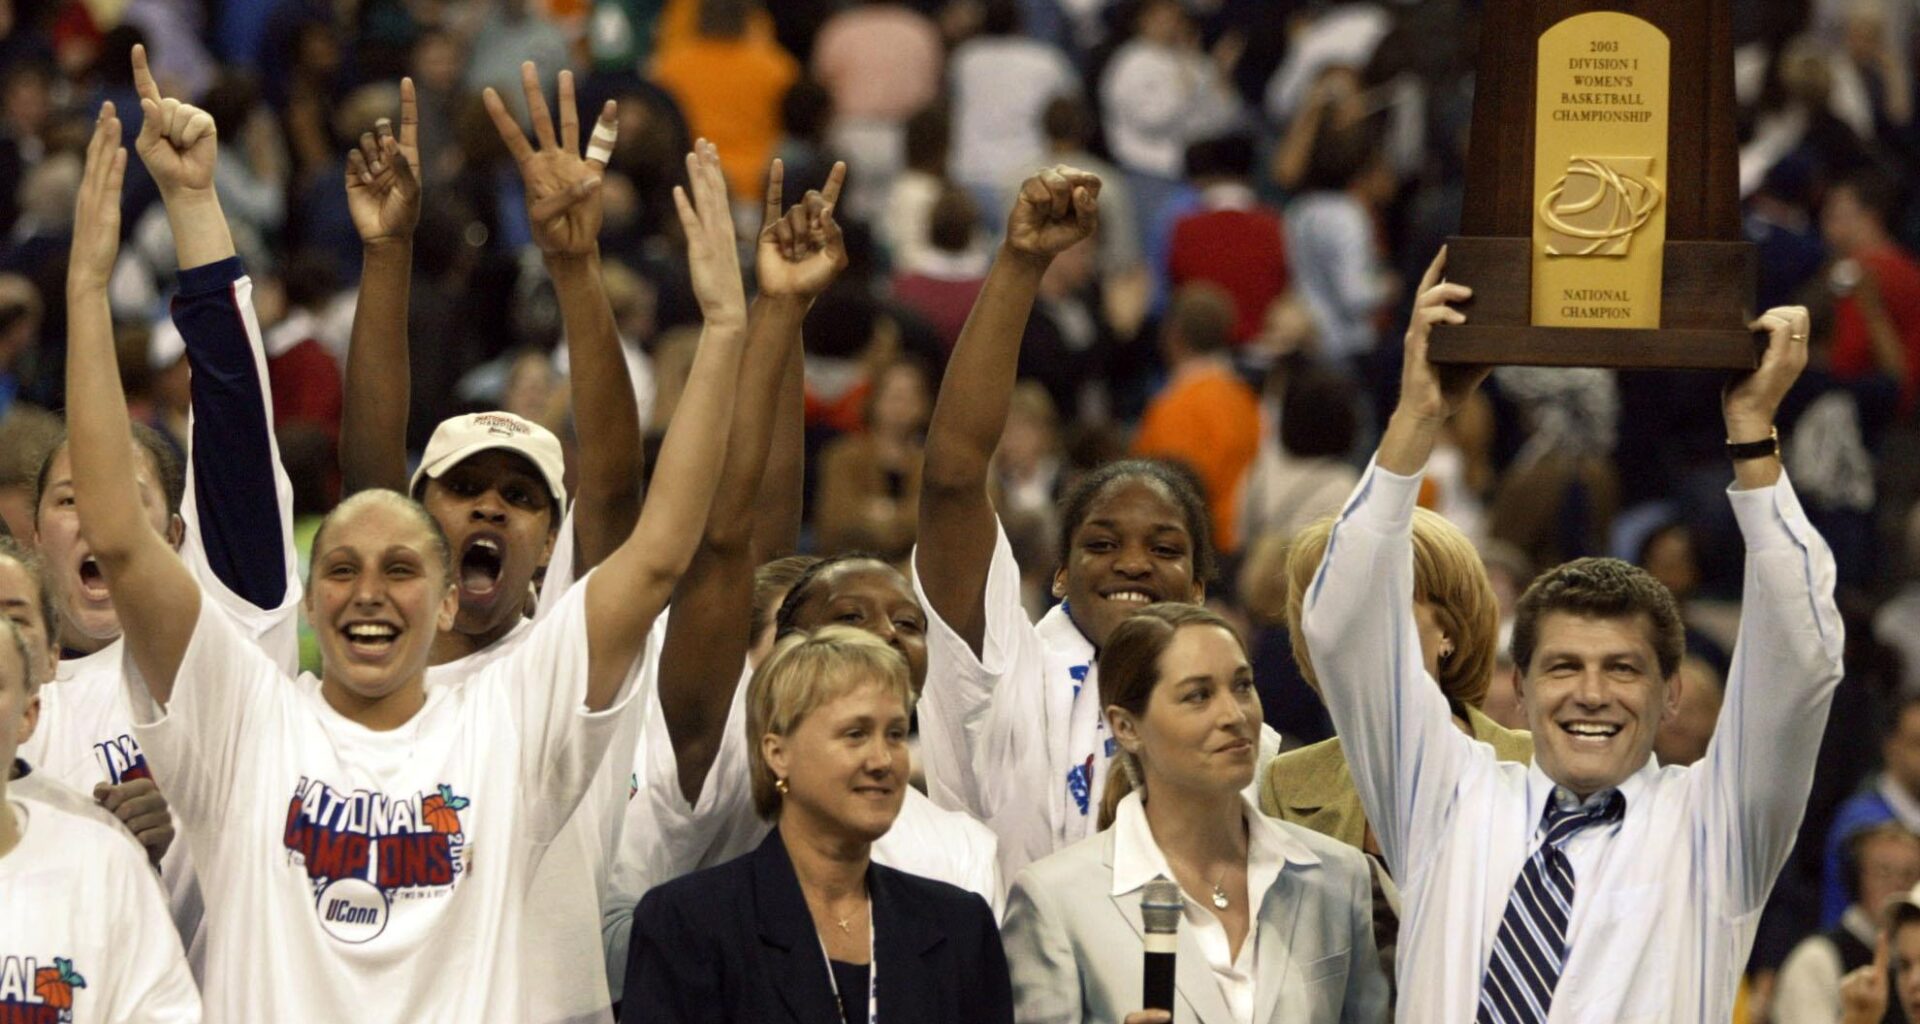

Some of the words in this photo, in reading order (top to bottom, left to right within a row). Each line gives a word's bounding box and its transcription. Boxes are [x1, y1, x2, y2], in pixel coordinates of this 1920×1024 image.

[1590, 41, 1619, 53] 2003
[1568, 58, 1629, 70] DIVISION
[1633, 58, 1638, 70] I
[1573, 75, 1633, 87] WOMEN'S
[1562, 93, 1644, 105] BASKETBALL
[1552, 110, 1652, 123] CHAMPIONSHIP
[1563, 289, 1630, 302] NATIONAL
[1561, 306, 1631, 319] CHAMPION
[325, 899, 378, 924] UConn
